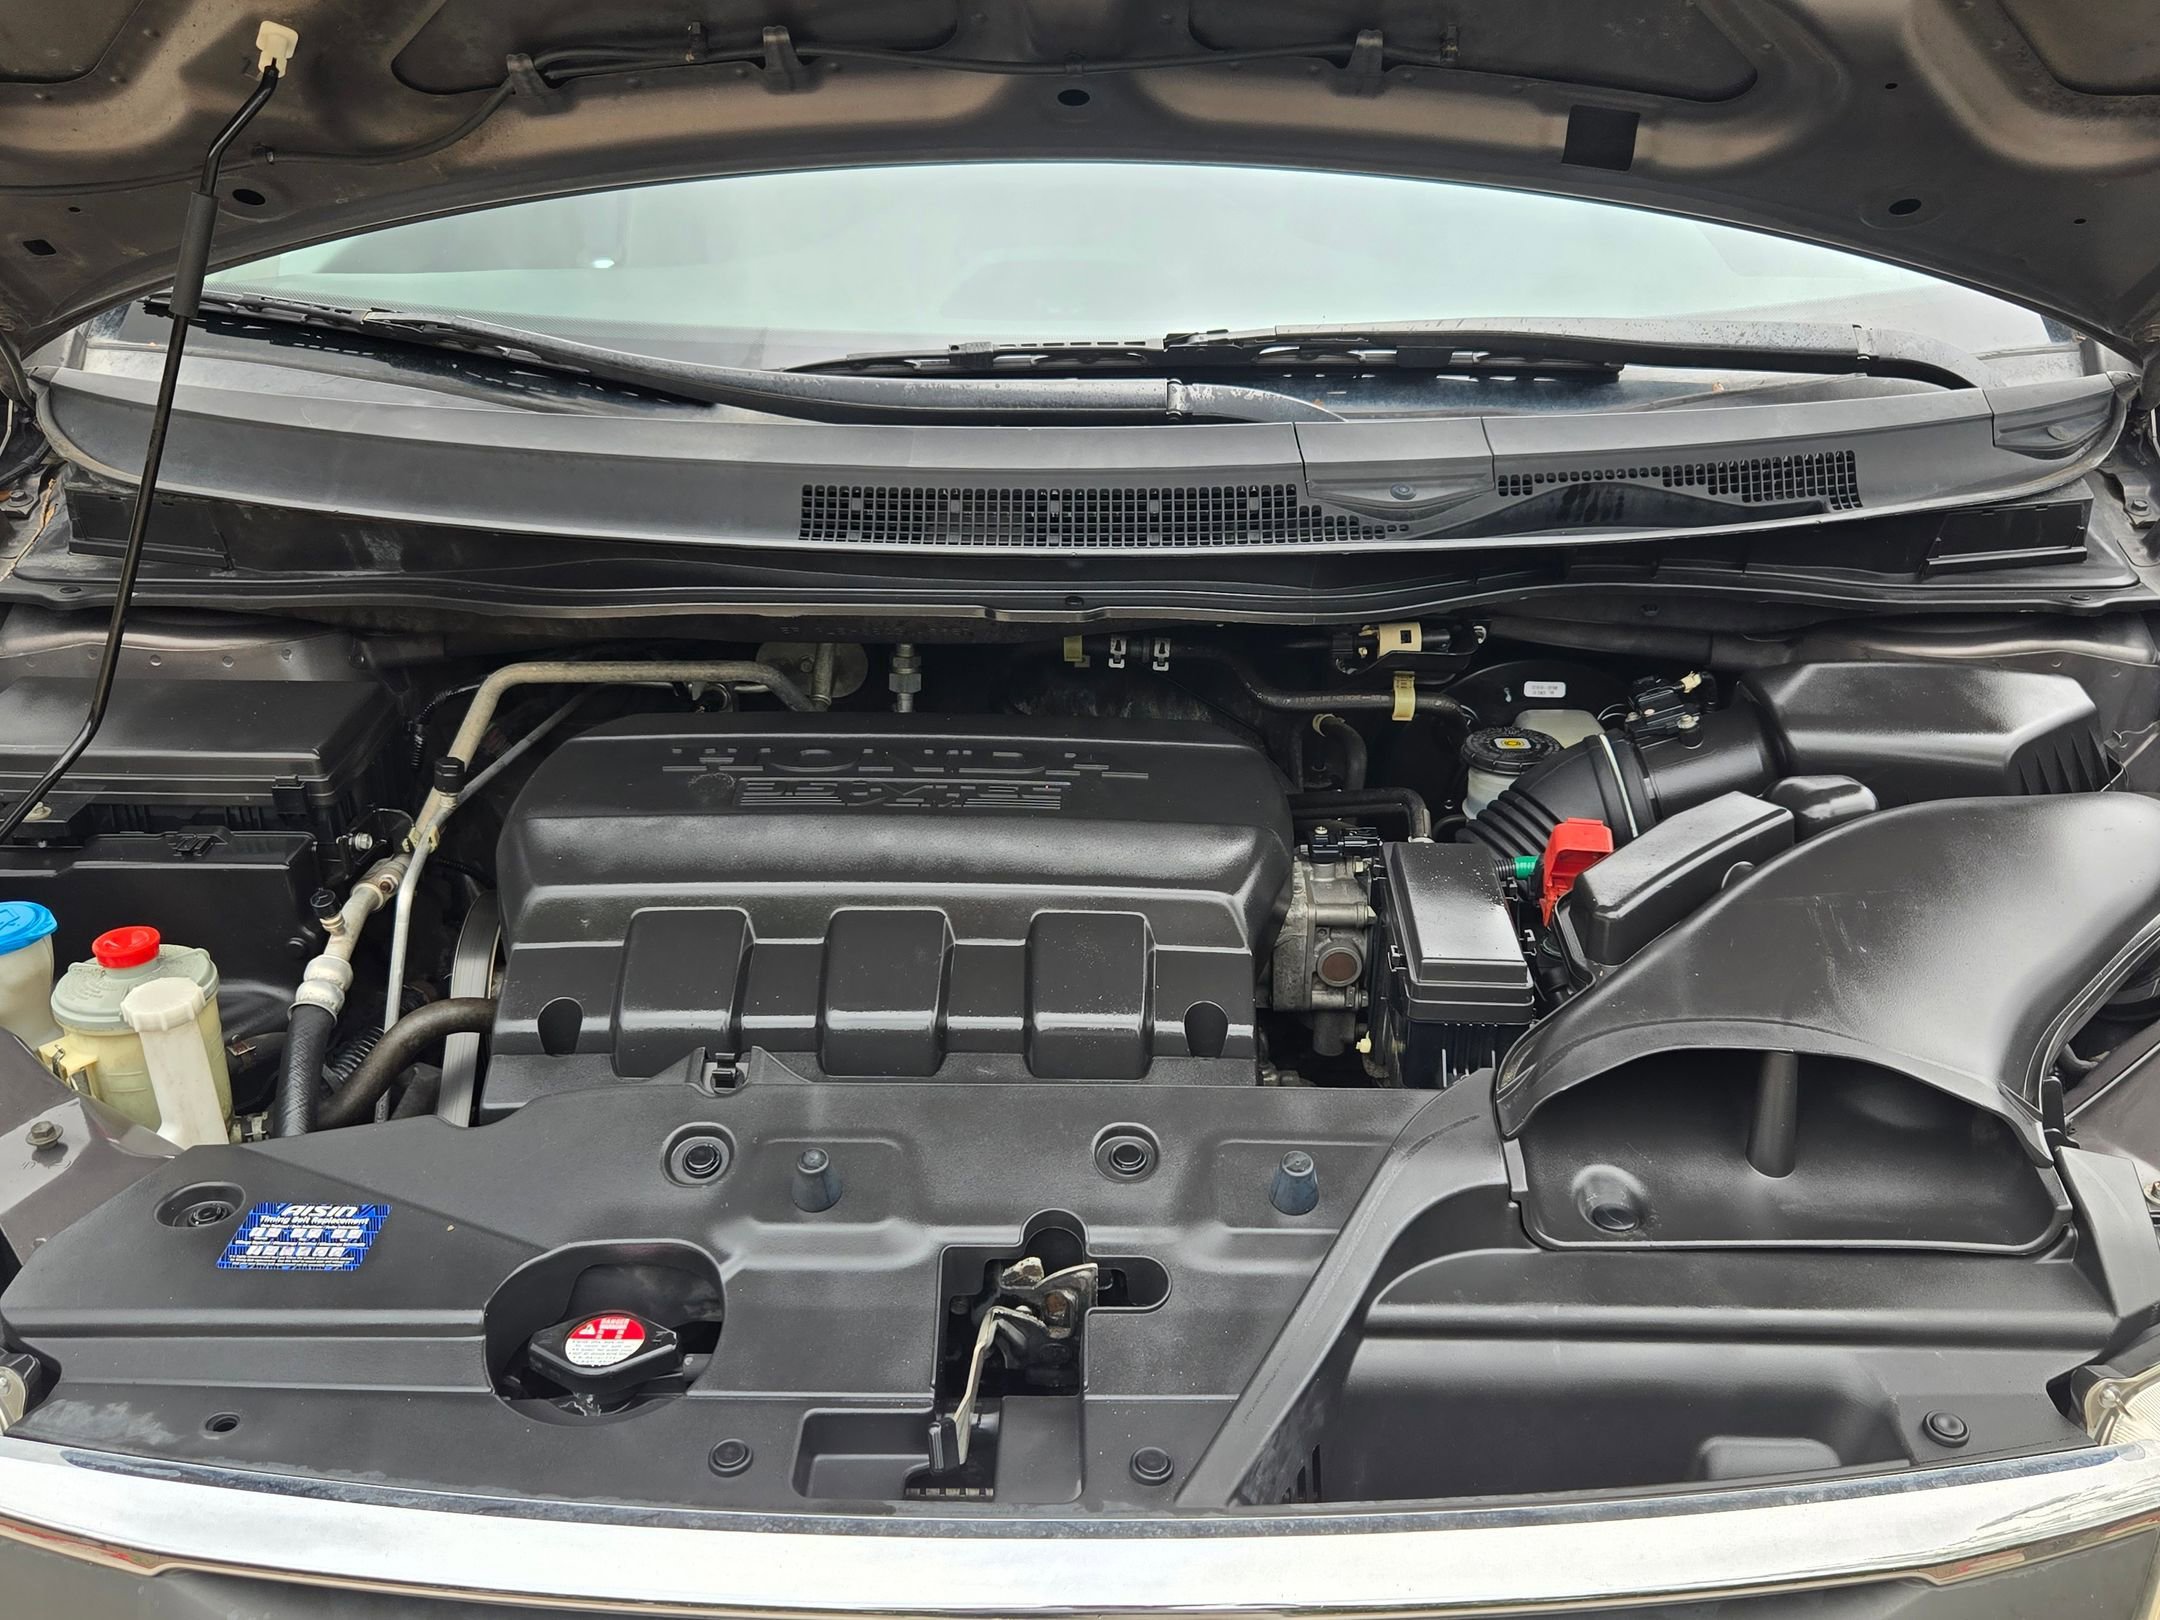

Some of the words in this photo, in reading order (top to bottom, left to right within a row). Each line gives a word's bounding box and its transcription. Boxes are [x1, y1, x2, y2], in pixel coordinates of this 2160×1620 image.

[662, 747, 1149, 779] HONDA
[281, 1205, 358, 1217] AISIN
[260, 1215, 291, 1226] Timing
[311, 1217, 370, 1227] Replacement
